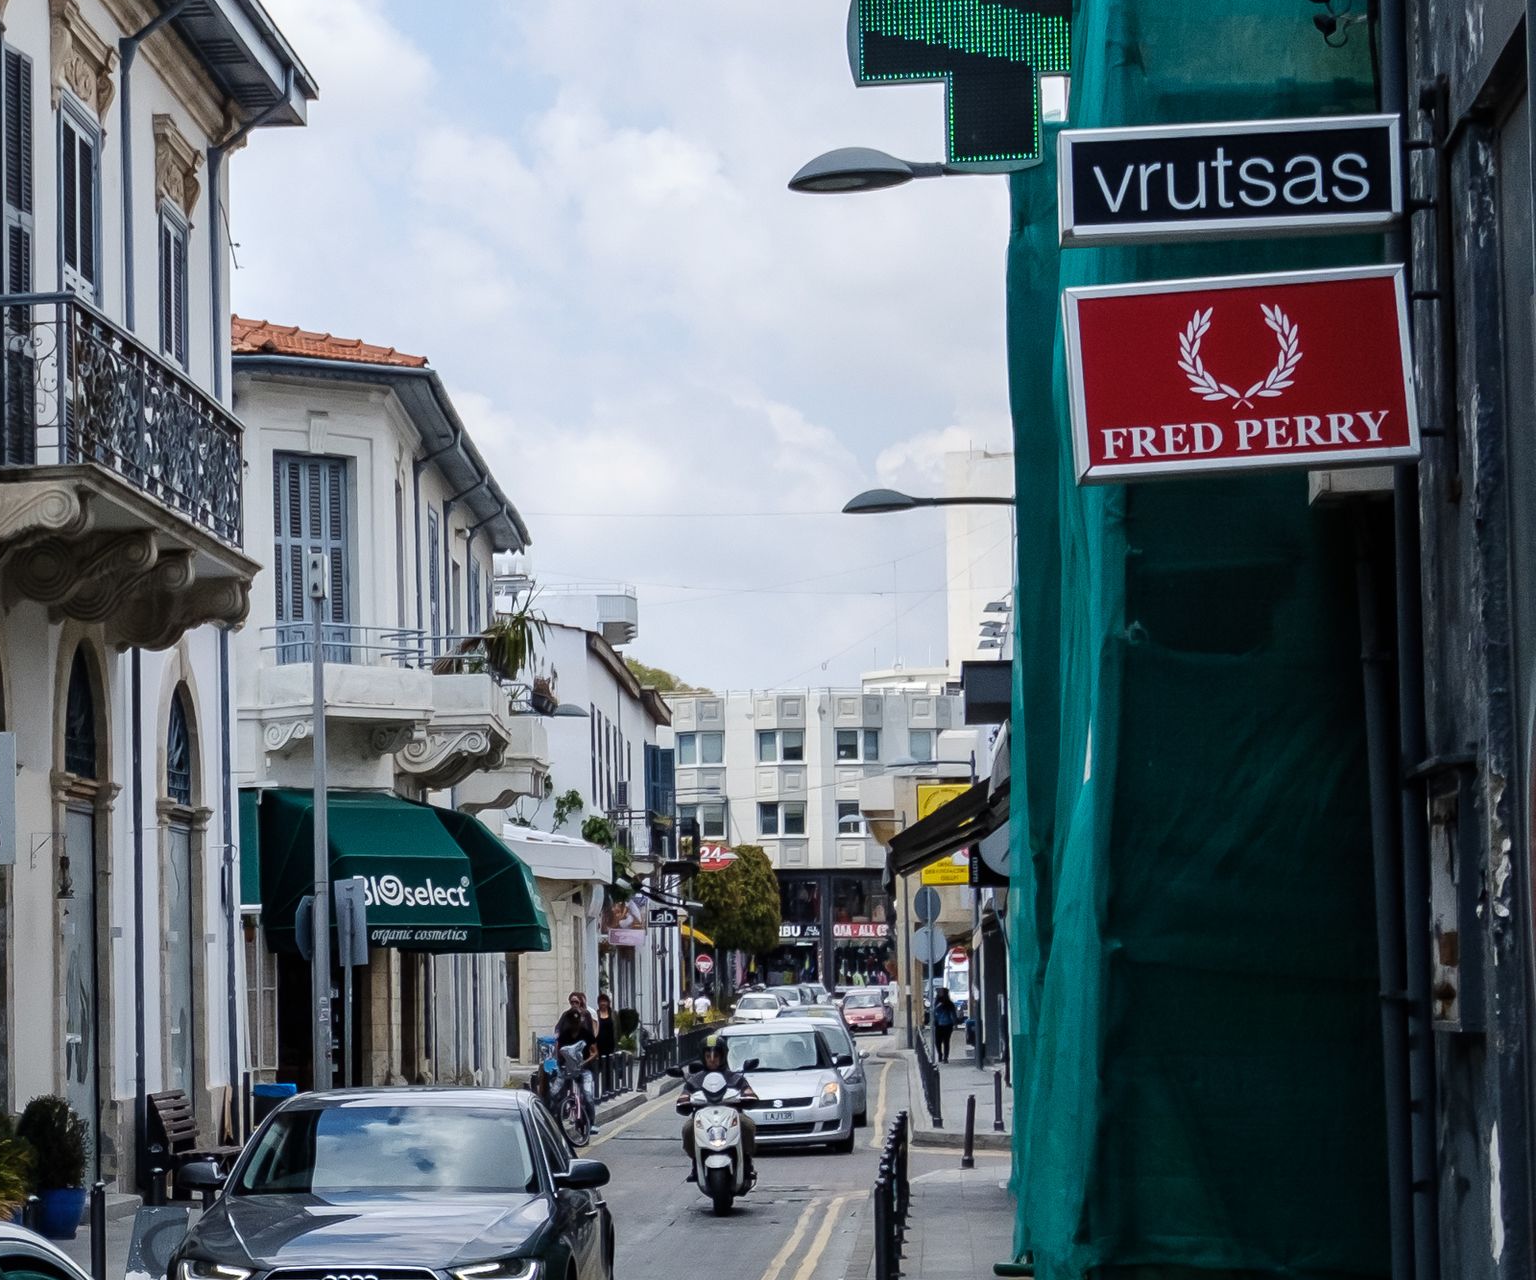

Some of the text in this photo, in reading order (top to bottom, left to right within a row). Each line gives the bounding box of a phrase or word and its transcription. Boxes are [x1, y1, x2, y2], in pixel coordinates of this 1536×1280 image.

[1093, 146, 1370, 213] vrutsas
[1102, 409, 1390, 460] FRED PERRY
[700, 846, 722, 862] 24
[649, 911, 676, 924] Lab.
[371, 926, 467, 945] organic cosmetics
